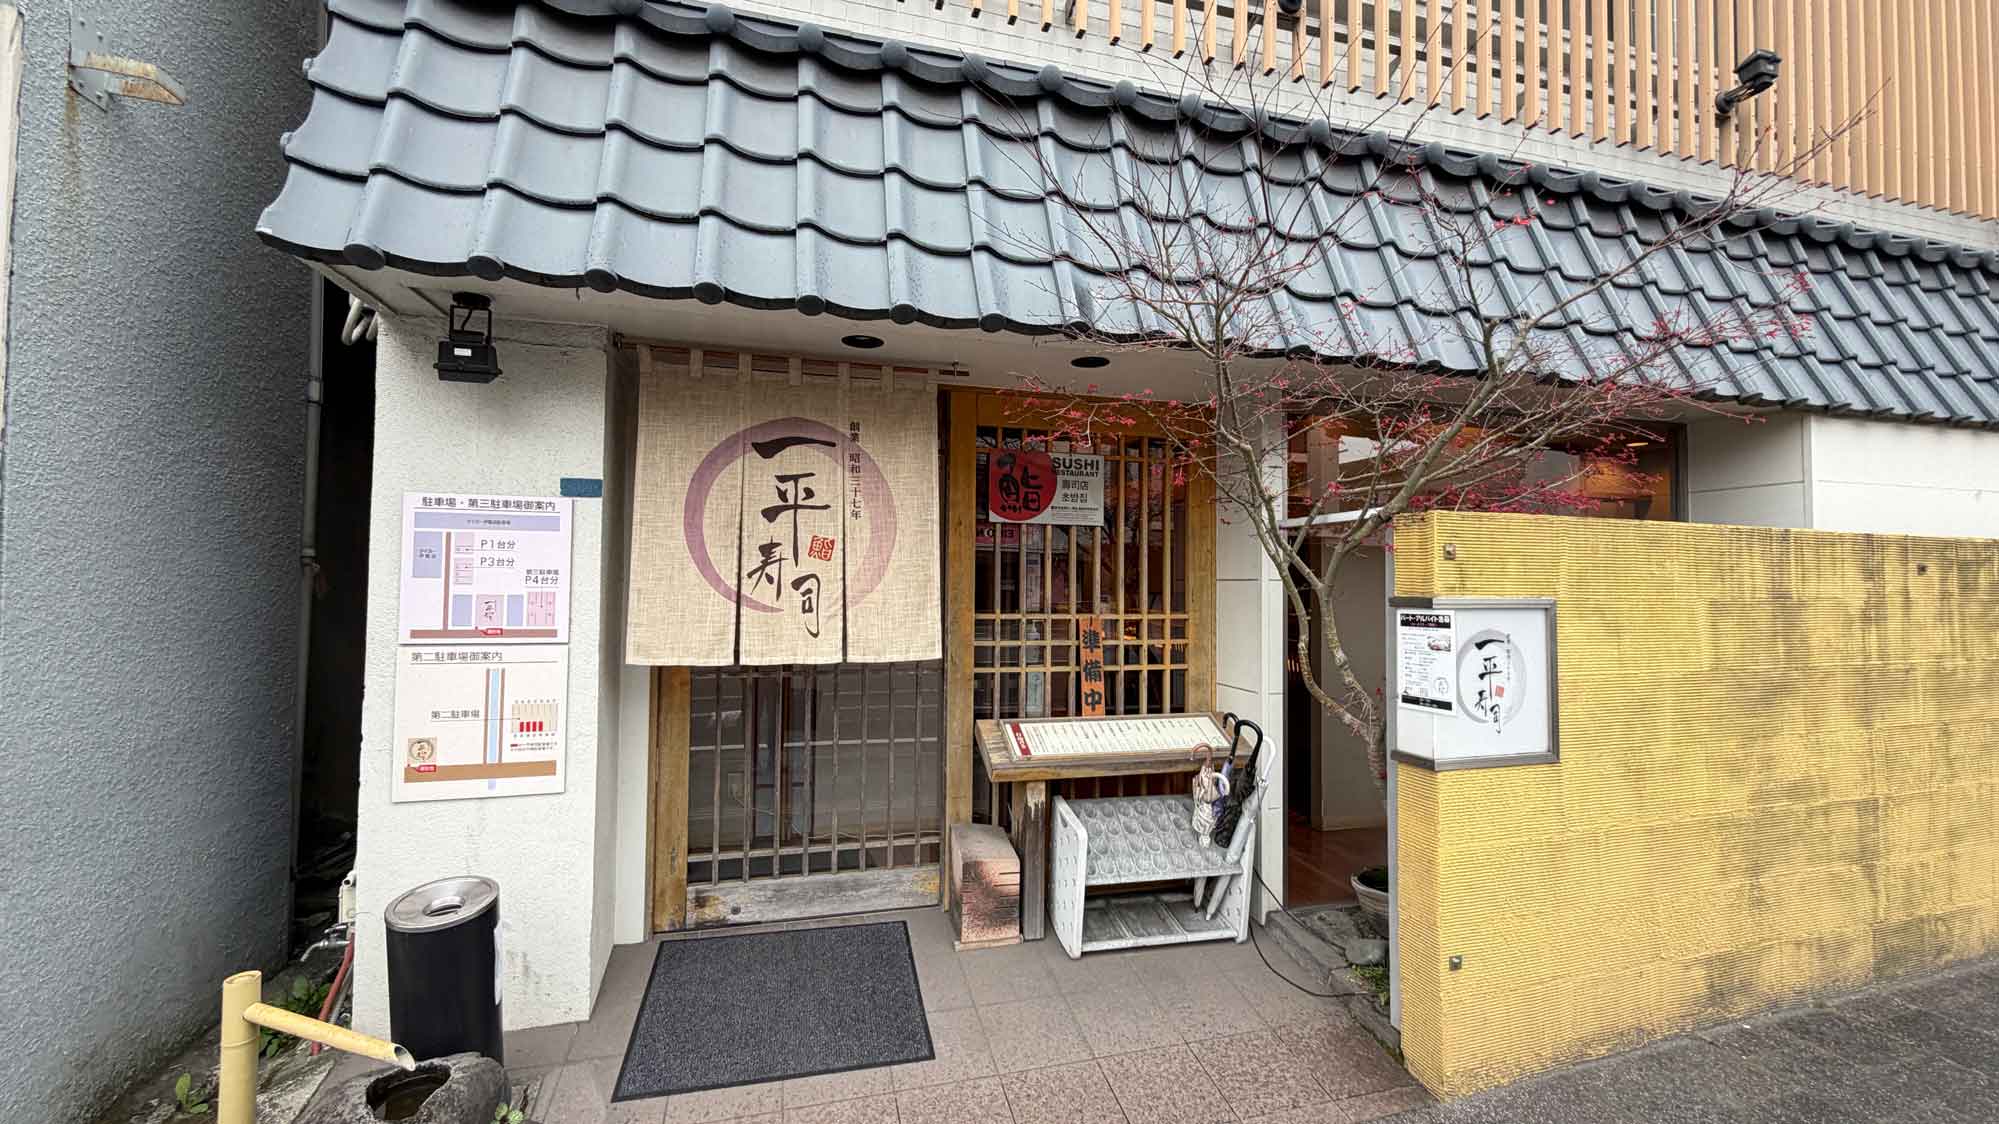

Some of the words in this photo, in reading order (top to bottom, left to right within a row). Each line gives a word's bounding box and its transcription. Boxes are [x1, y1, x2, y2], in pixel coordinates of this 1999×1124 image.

[1052, 456, 1100, 471] SUSHI
[1051, 469, 1099, 478] ESTAURANT
[747, 435, 837, 639] 一平寿司
[480, 539, 517, 550] P1台分
[479, 557, 516, 568] P3台分
[525, 575, 559, 585] P4台分
[411, 651, 503, 663] 第二駐車場御案内
[1081, 627, 1104, 714] 準備中
[1474, 638, 1505, 734] 一平寿司
[431, 710, 480, 719] 第二駐車場
